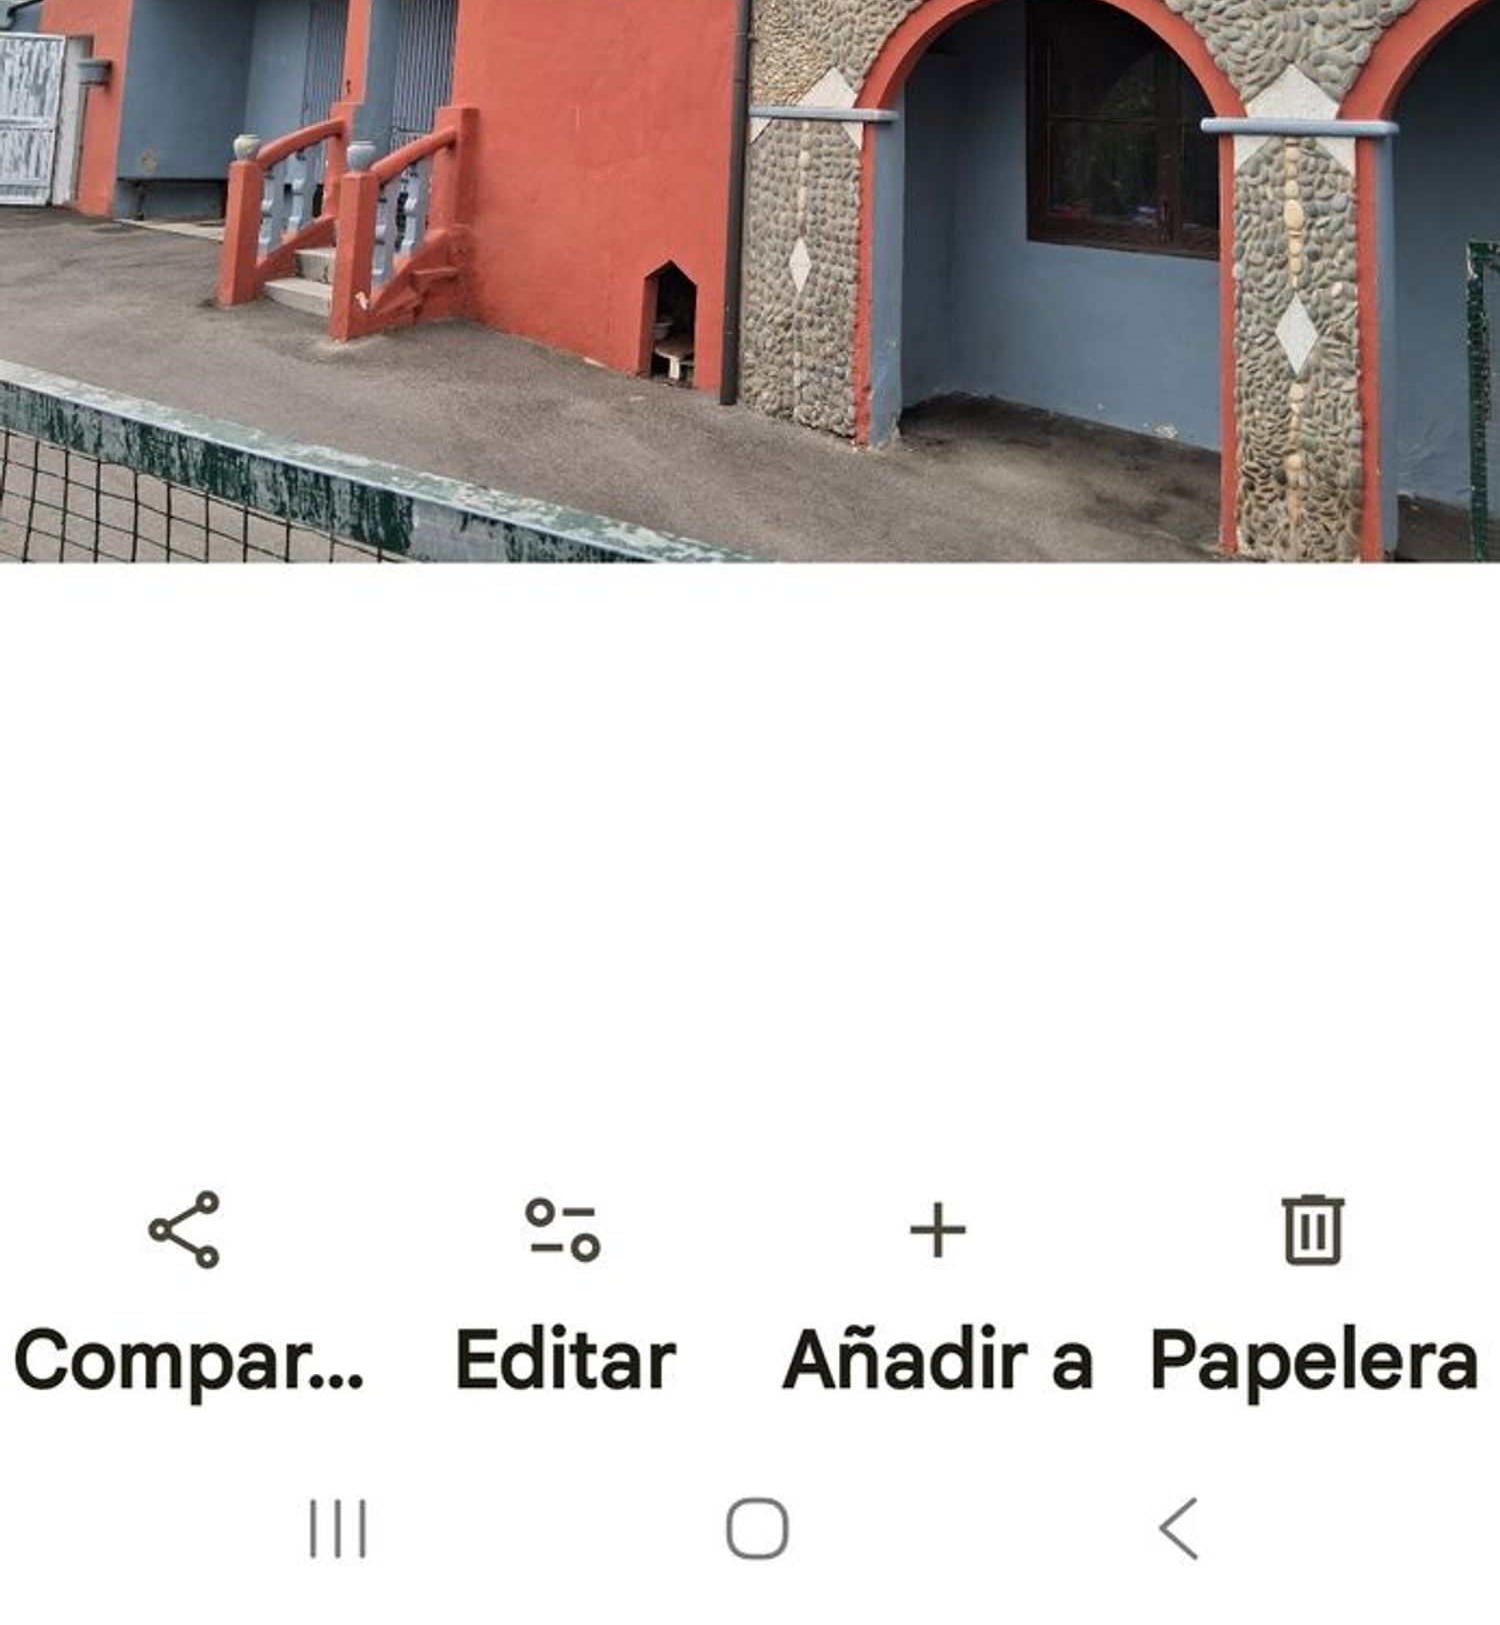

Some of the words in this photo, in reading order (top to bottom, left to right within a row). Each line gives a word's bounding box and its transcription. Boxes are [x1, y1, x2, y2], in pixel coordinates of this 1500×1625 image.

[14, 1327, 364, 1407] Compar...
[457, 1323, 678, 1391] Editar
[781, 1323, 1029, 1391] Añadir
[1052, 1342, 1093, 1391] a
[1152, 1323, 1478, 1407] Papelera
